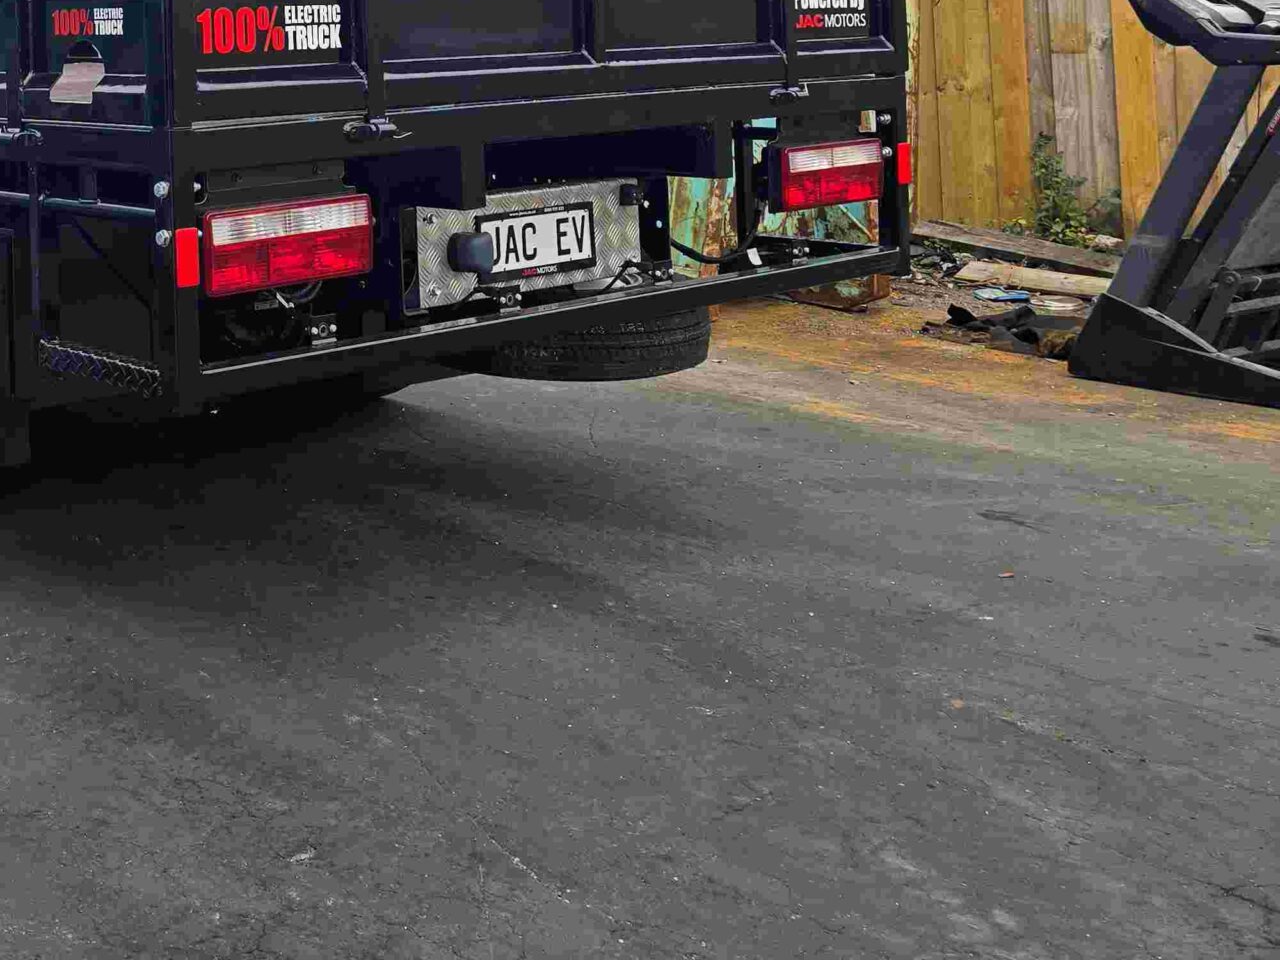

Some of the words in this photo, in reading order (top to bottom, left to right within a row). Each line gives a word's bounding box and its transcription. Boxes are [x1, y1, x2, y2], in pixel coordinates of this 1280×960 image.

[52, 8, 93, 36] 100%
[93, 7, 123, 20] ELECTRIC
[284, 4, 341, 24] ELECTRIC
[795, 13, 824, 29] JAC
[824, 12, 867, 28] MOTORS
[94, 19, 124, 36] TRUCK
[196, 5, 285, 55] 100%
[284, 23, 342, 51] TRUCK
[492, 222, 538, 267] JAC
[556, 214, 586, 257] EV
